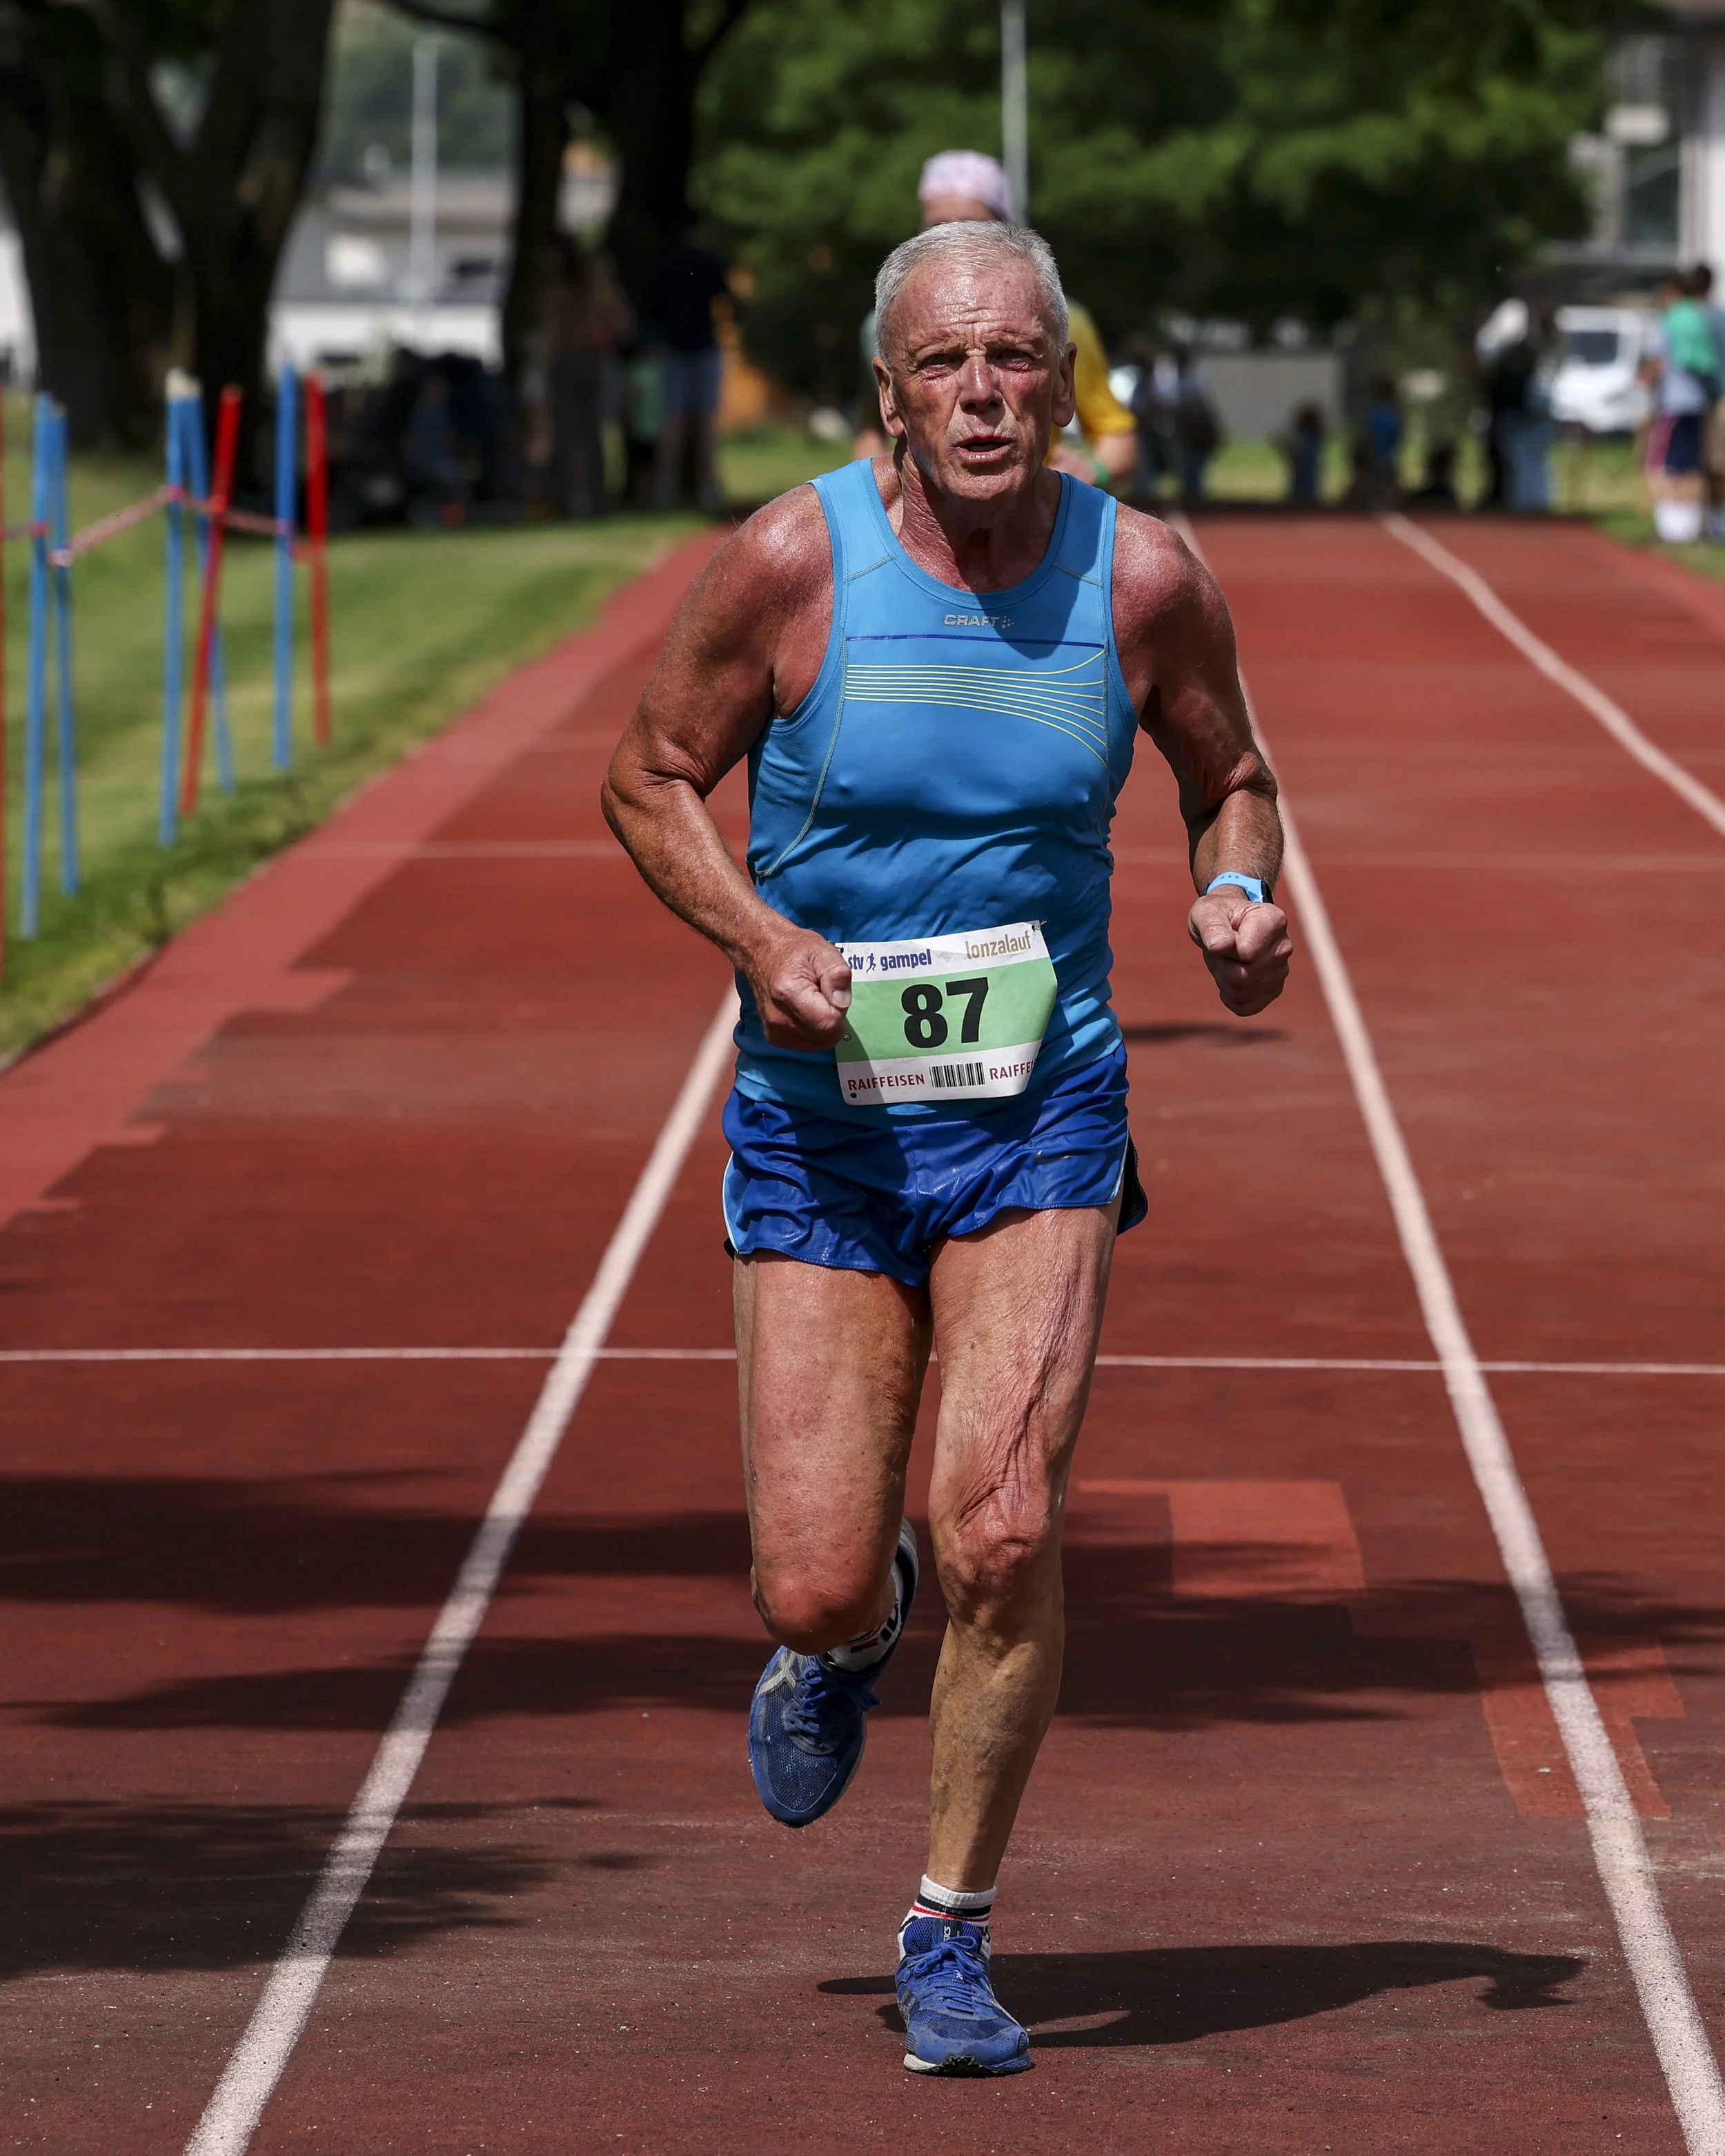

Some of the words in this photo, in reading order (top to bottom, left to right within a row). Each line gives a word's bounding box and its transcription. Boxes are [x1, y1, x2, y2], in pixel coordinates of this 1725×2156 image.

[944, 614, 1000, 627] CRAFT
[965, 930, 1031, 959] lonzalauf
[848, 954, 864, 970] stv
[880, 949, 932, 971] gampel
[900, 976, 989, 1049] 87
[989, 1058, 1036, 1080] RAIFFEI
[847, 1074, 925, 1091] RAIFFEISEN
